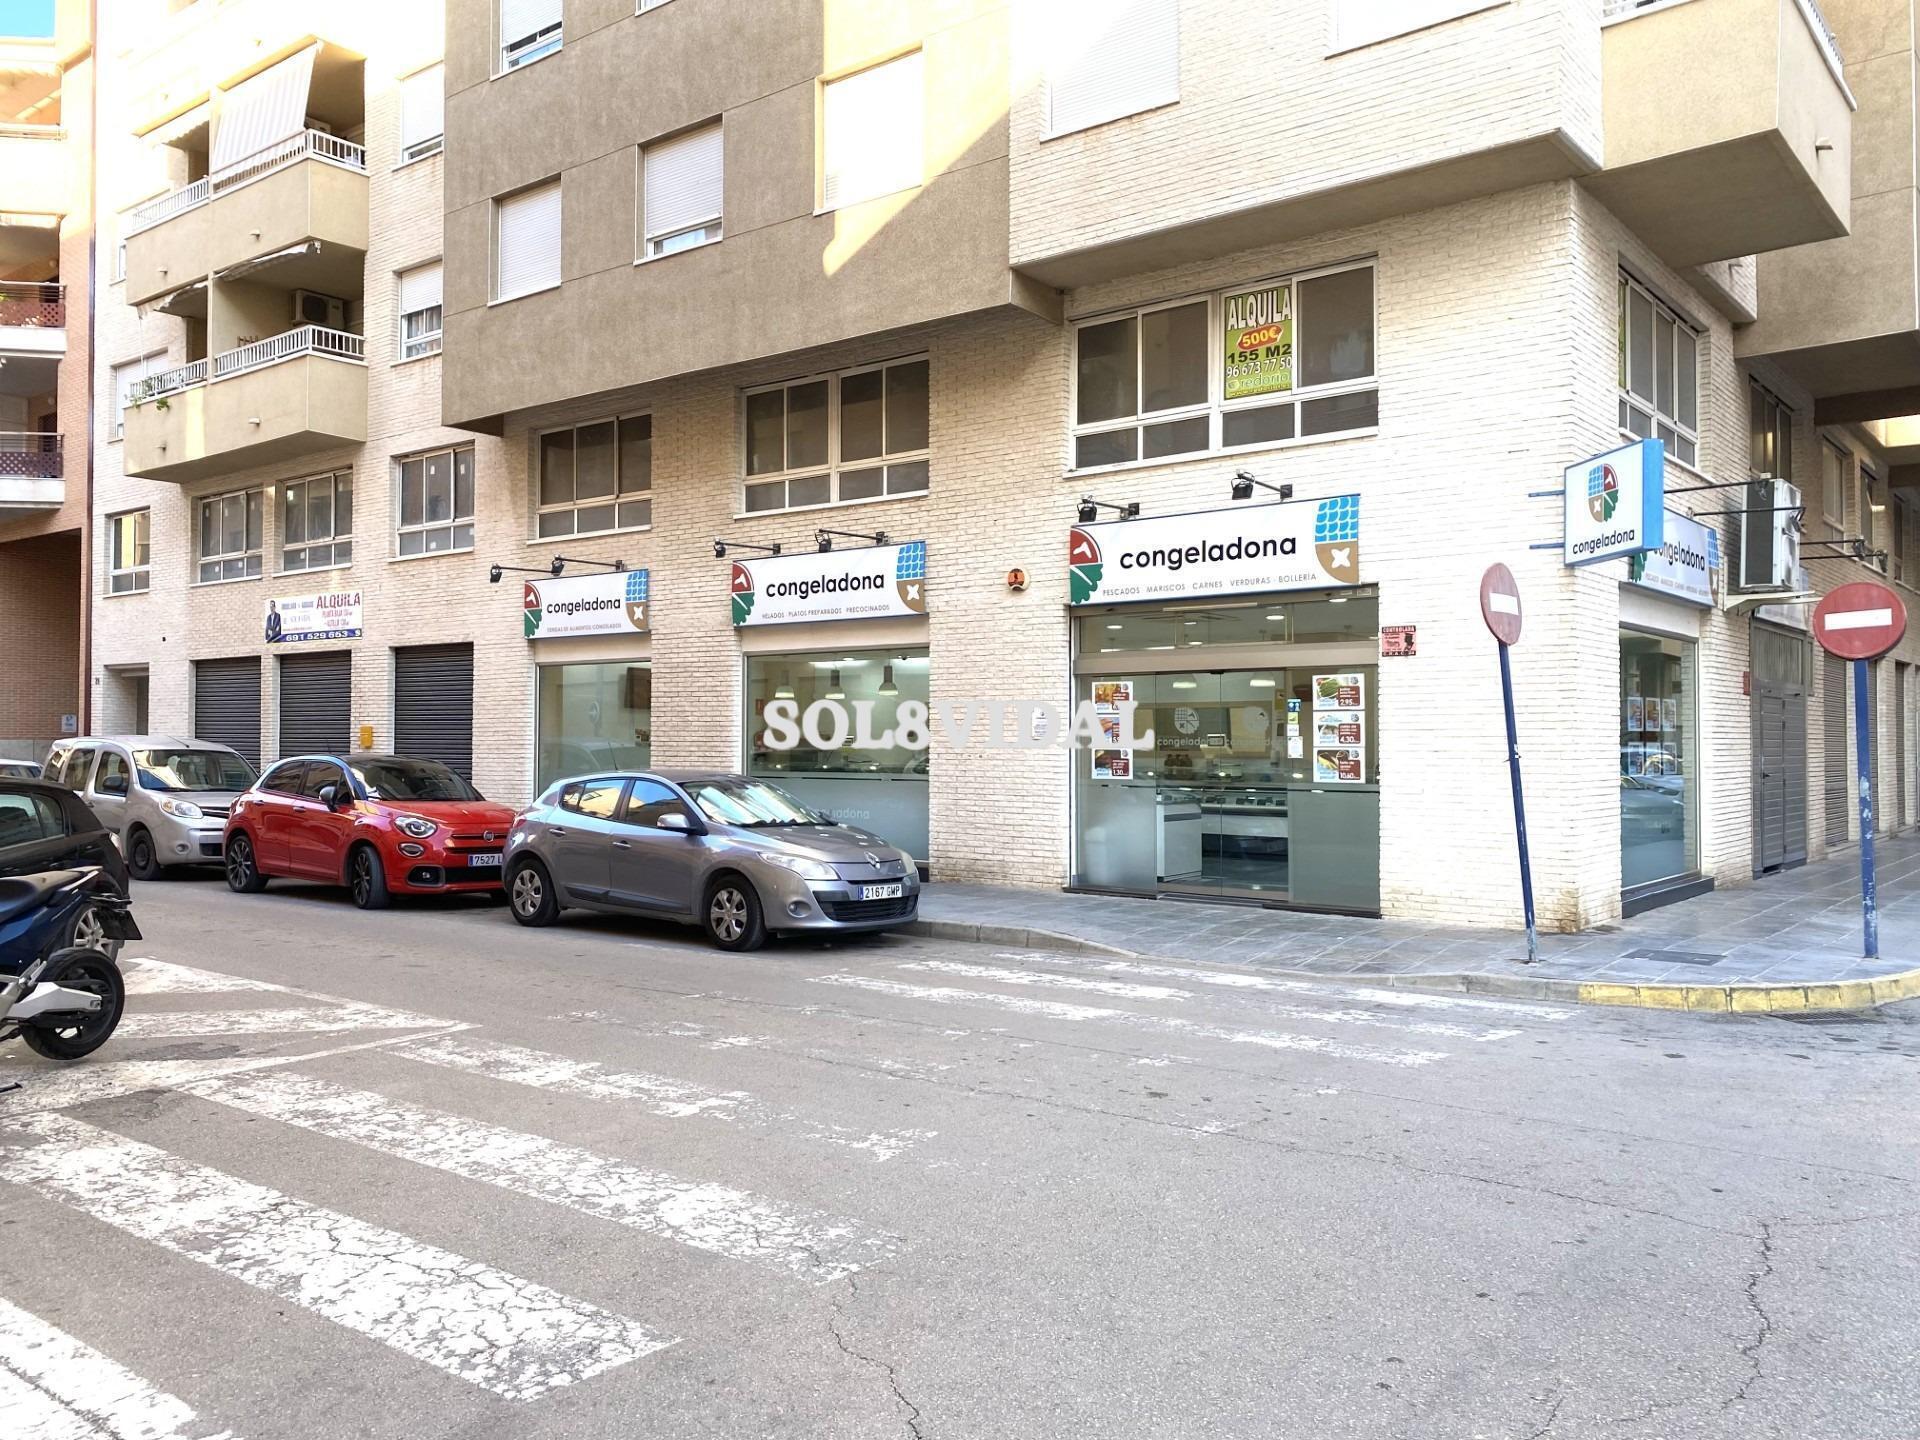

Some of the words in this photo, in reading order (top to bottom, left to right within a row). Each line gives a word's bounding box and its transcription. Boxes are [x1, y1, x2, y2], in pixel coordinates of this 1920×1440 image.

[1227, 287, 1292, 331] ALQUILA
[1242, 326, 1279, 347] 500€
[1228, 348, 1260, 365] 155
[1265, 343, 1292, 358] M2
[1226, 364, 1240, 378] 96
[1241, 361, 1261, 376] 673
[1264, 358, 1277, 372] 77
[1280, 356, 1292, 370] 50
[1572, 529, 1635, 555] congeladona
[1119, 537, 1296, 570] congeladona
[766, 573, 885, 599] congeladona
[1102, 586, 1140, 597] PESCADOS
[1146, 583, 1186, 593] MARISCOS
[1192, 580, 1223, 590] CARNES
[1230, 576, 1271, 587] VERDURAS
[316, 592, 361, 609] ALQUILA
[546, 597, 621, 616] congeladona
[846, 604, 890, 613] PRECOCINADOS
[474, 855, 496, 865] 7527
[864, 886, 885, 899] 2167
